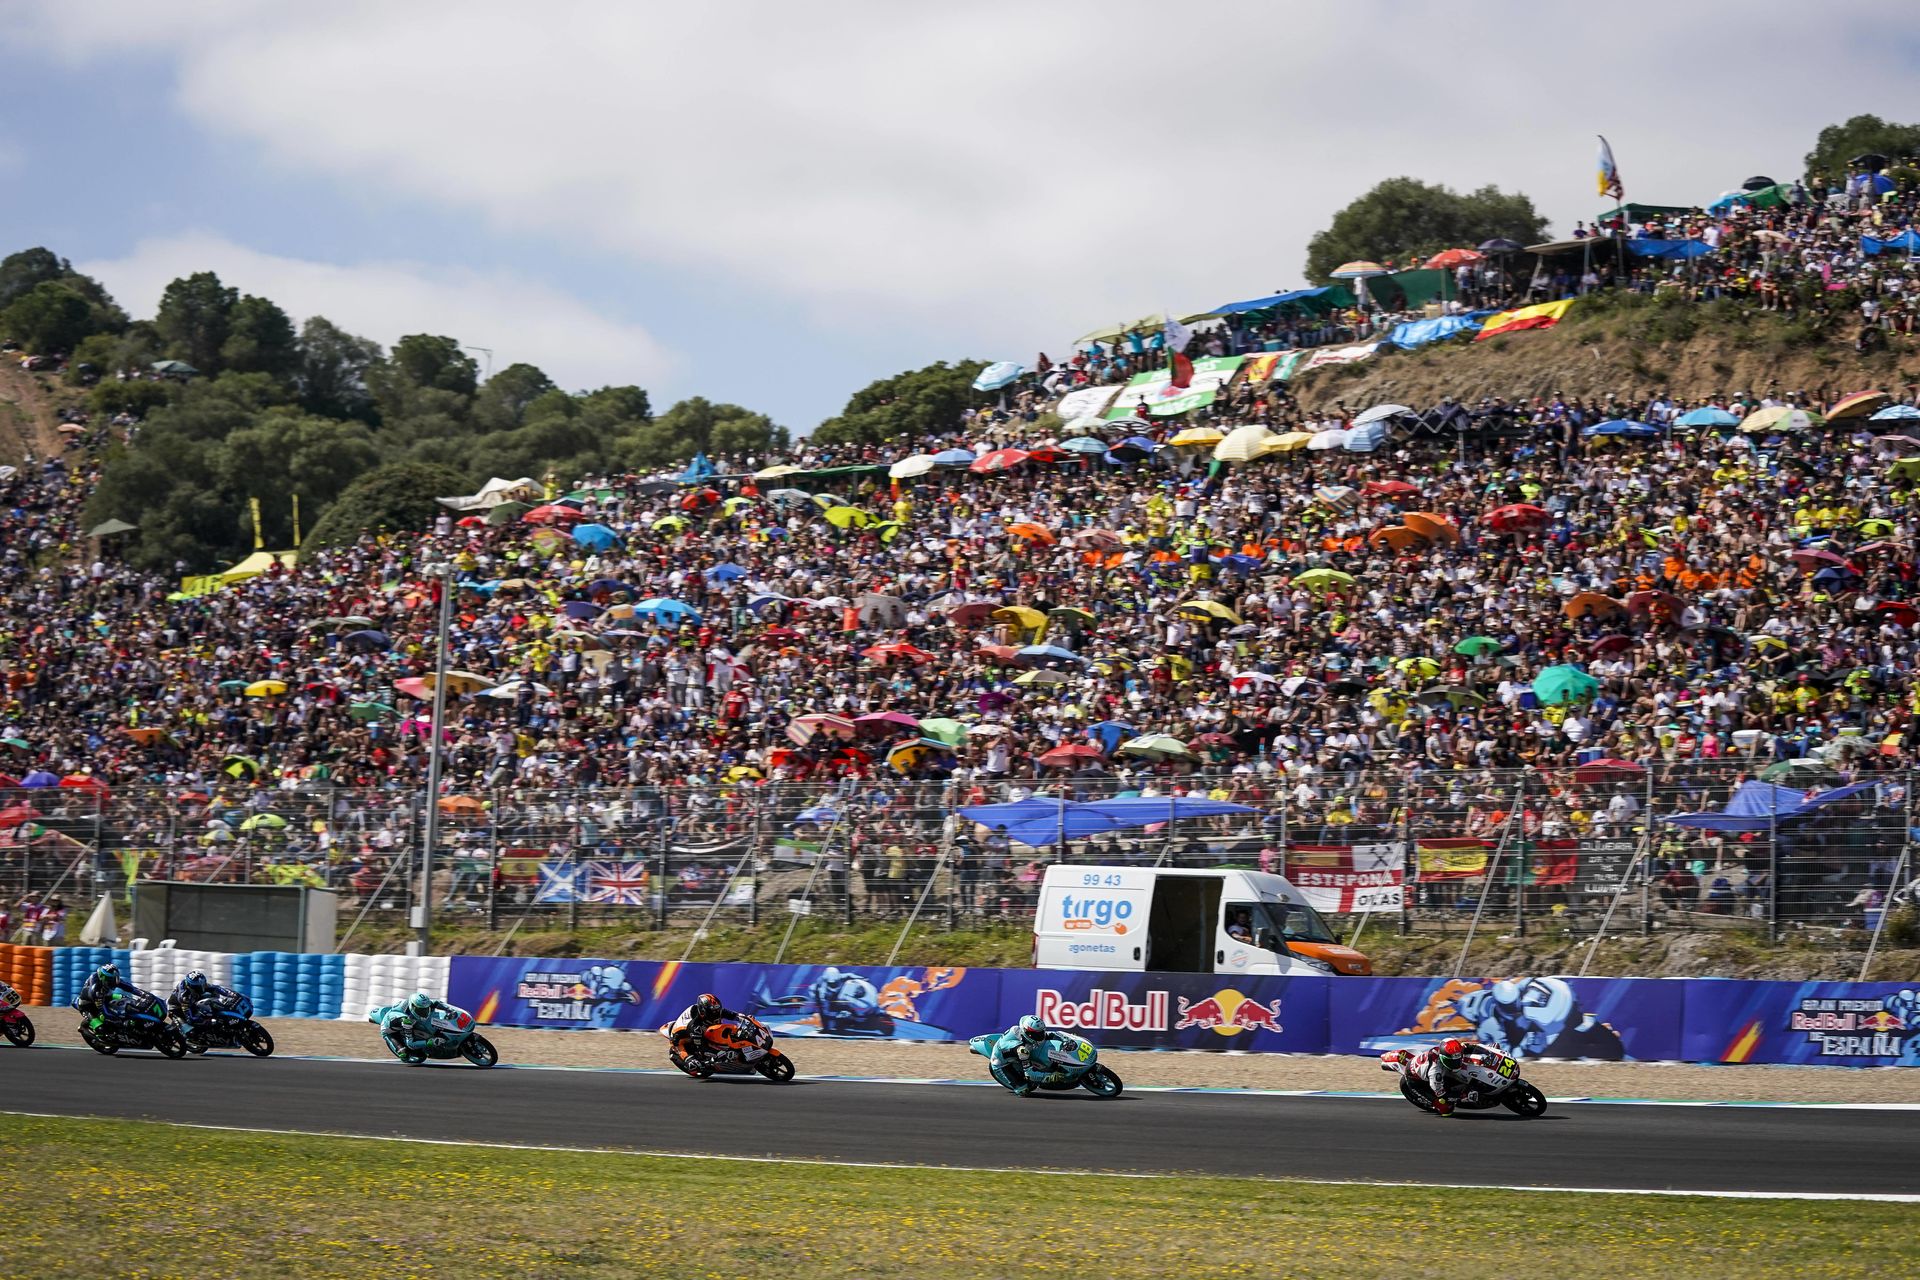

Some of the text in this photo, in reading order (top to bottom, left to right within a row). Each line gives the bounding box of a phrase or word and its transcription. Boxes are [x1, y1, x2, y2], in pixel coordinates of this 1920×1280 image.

[1083, 873, 1122, 887] 99 43
[1297, 872, 1395, 887] ESTEPONA
[1821, 1032, 1902, 1055] ESPAÑA
[1499, 1057, 1516, 1078] 24
